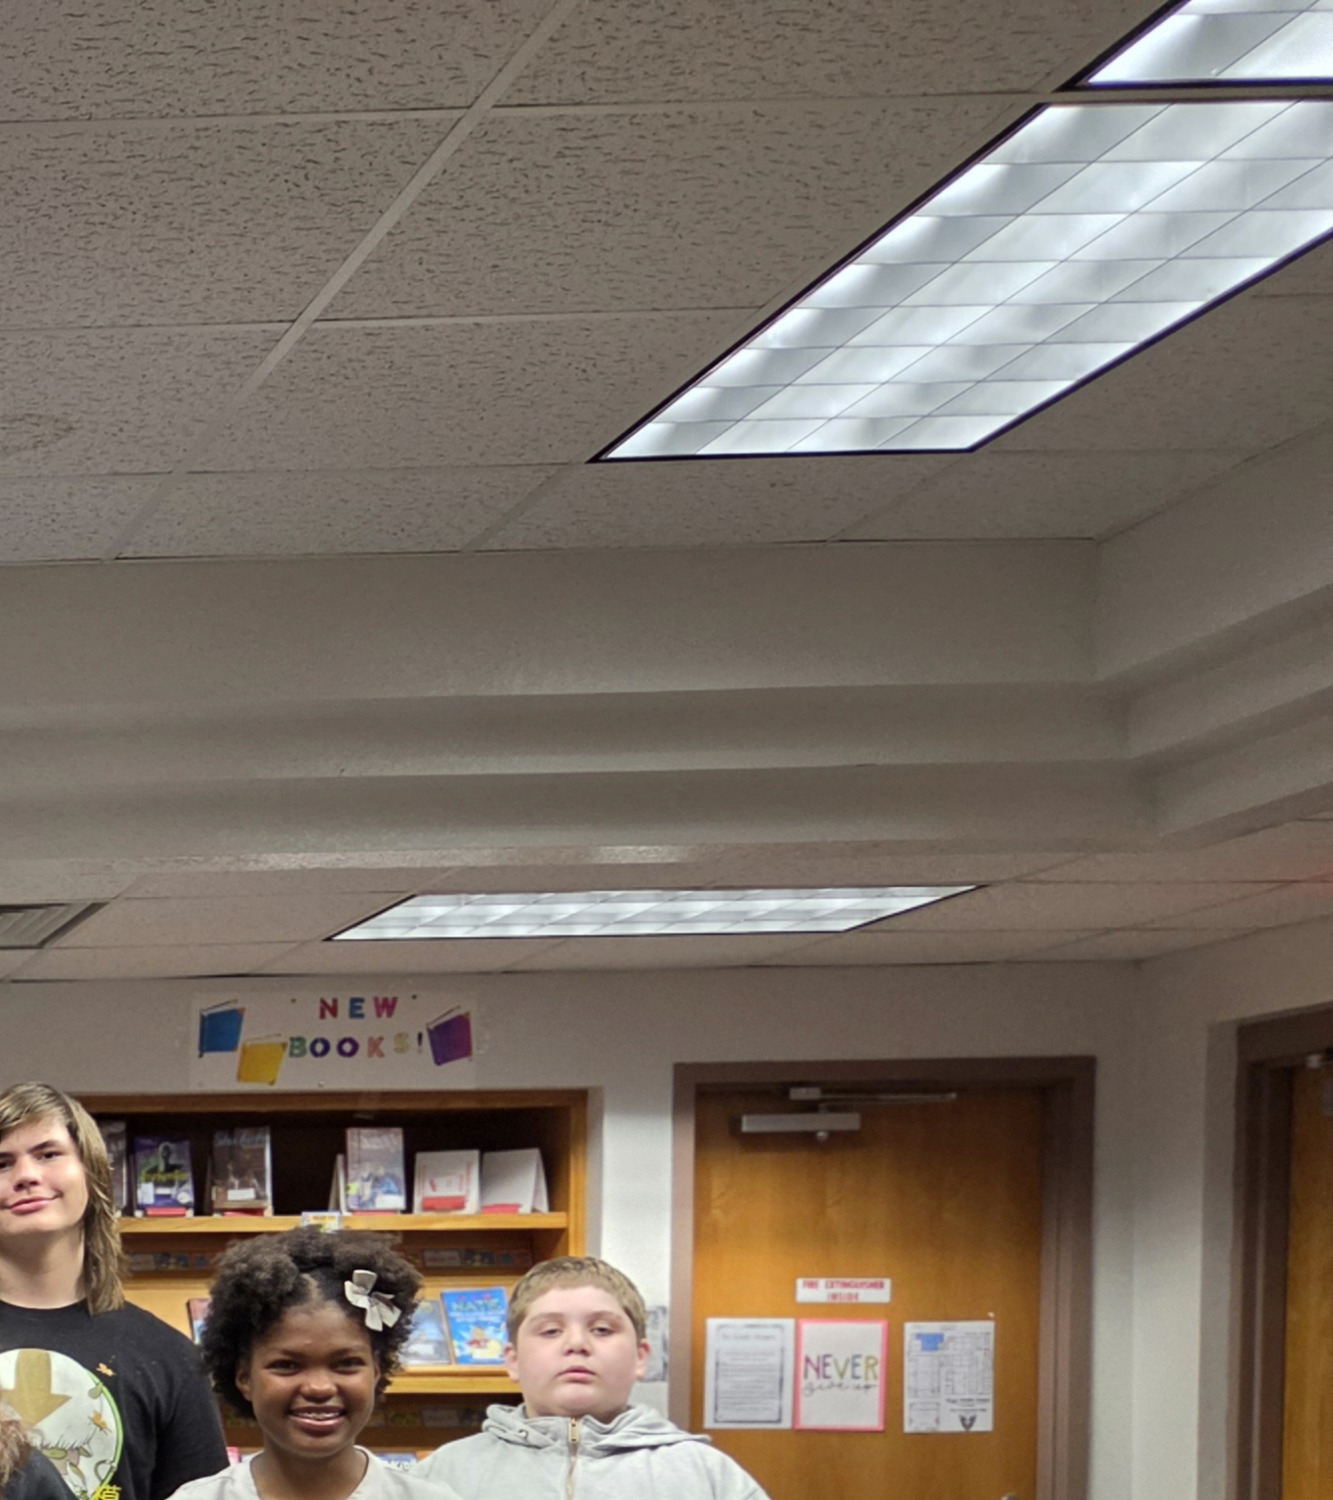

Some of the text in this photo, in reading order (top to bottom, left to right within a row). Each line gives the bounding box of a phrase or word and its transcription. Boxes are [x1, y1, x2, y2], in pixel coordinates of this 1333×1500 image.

[319, 997, 398, 1019] NEW
[289, 1032, 423, 1058] BOOKS!
[803, 1353, 879, 1381] NEVER
